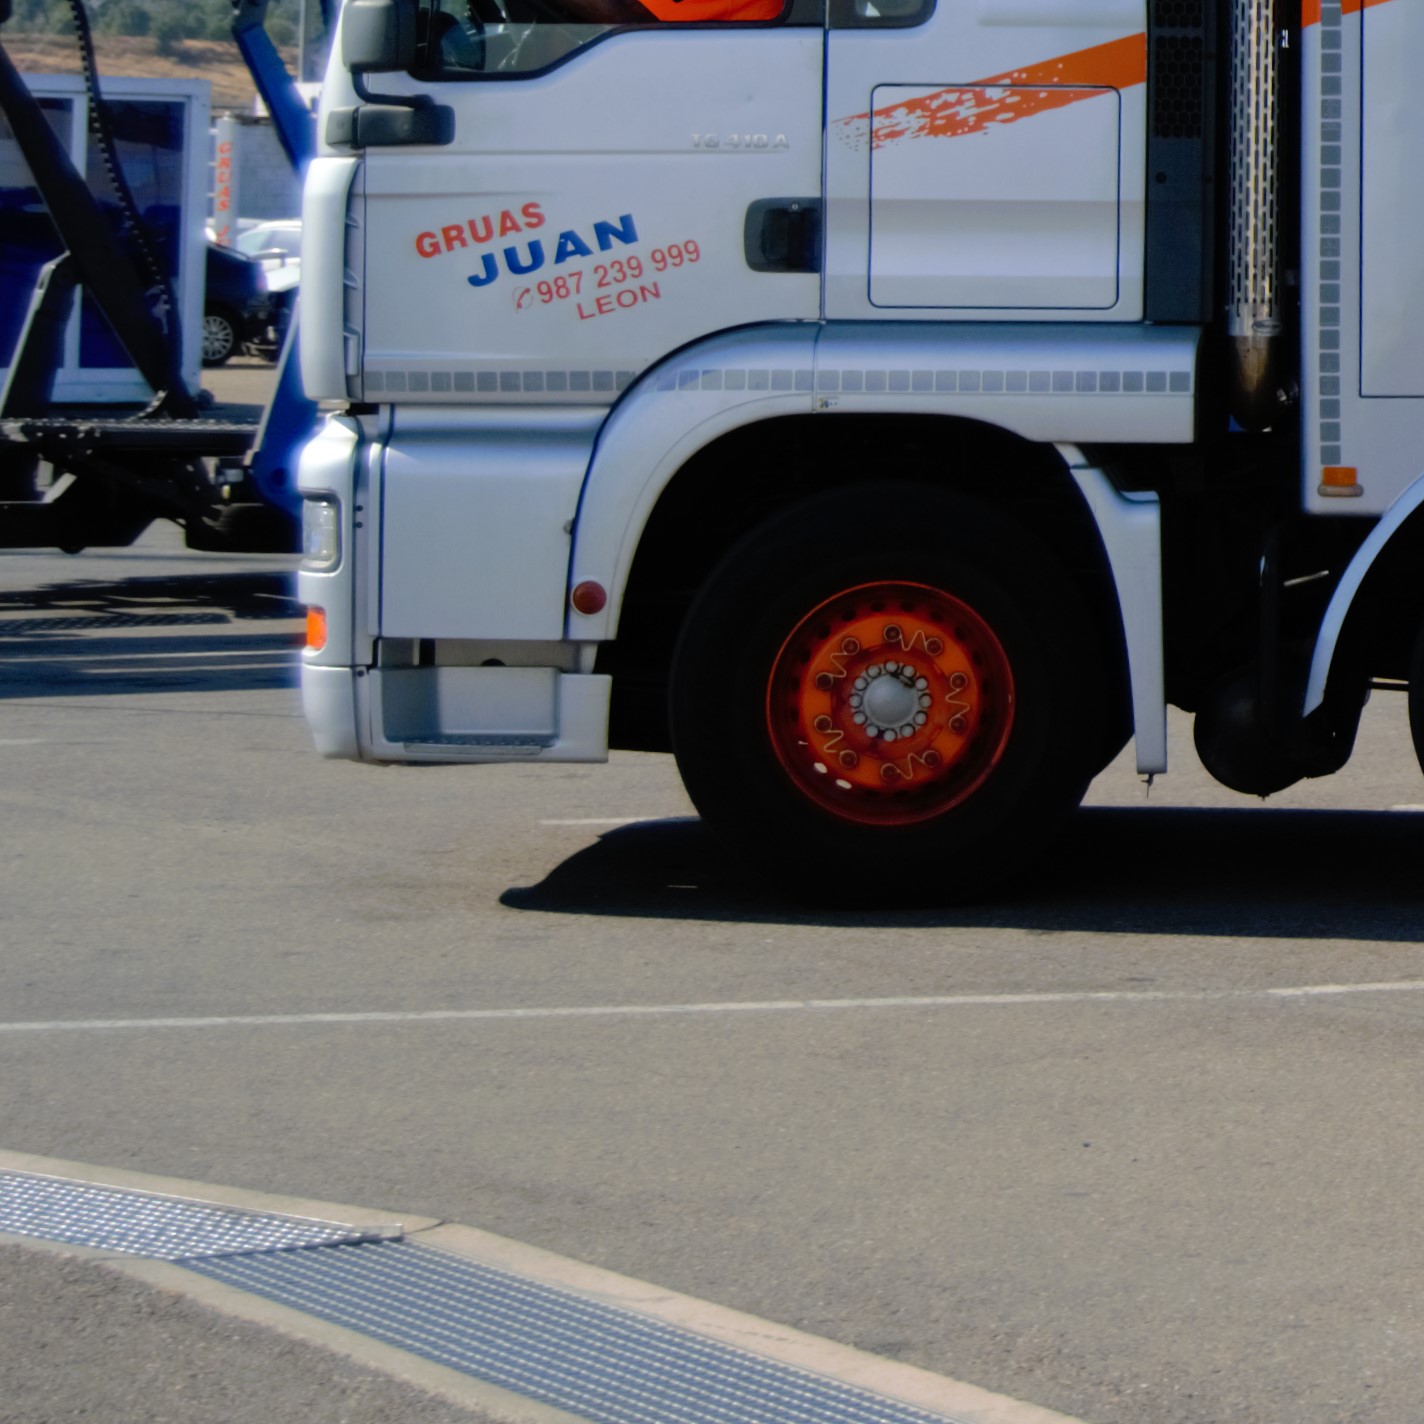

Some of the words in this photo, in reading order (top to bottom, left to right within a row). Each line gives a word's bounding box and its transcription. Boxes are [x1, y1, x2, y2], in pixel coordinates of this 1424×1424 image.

[723, 133, 769, 149] 410
[772, 133, 791, 149] A
[415, 201, 545, 259] GRUAS
[466, 213, 640, 288] JUAN
[535, 270, 584, 304] 987
[593, 255, 644, 289] 239
[650, 239, 701, 273] 999
[576, 281, 662, 321] LEON
